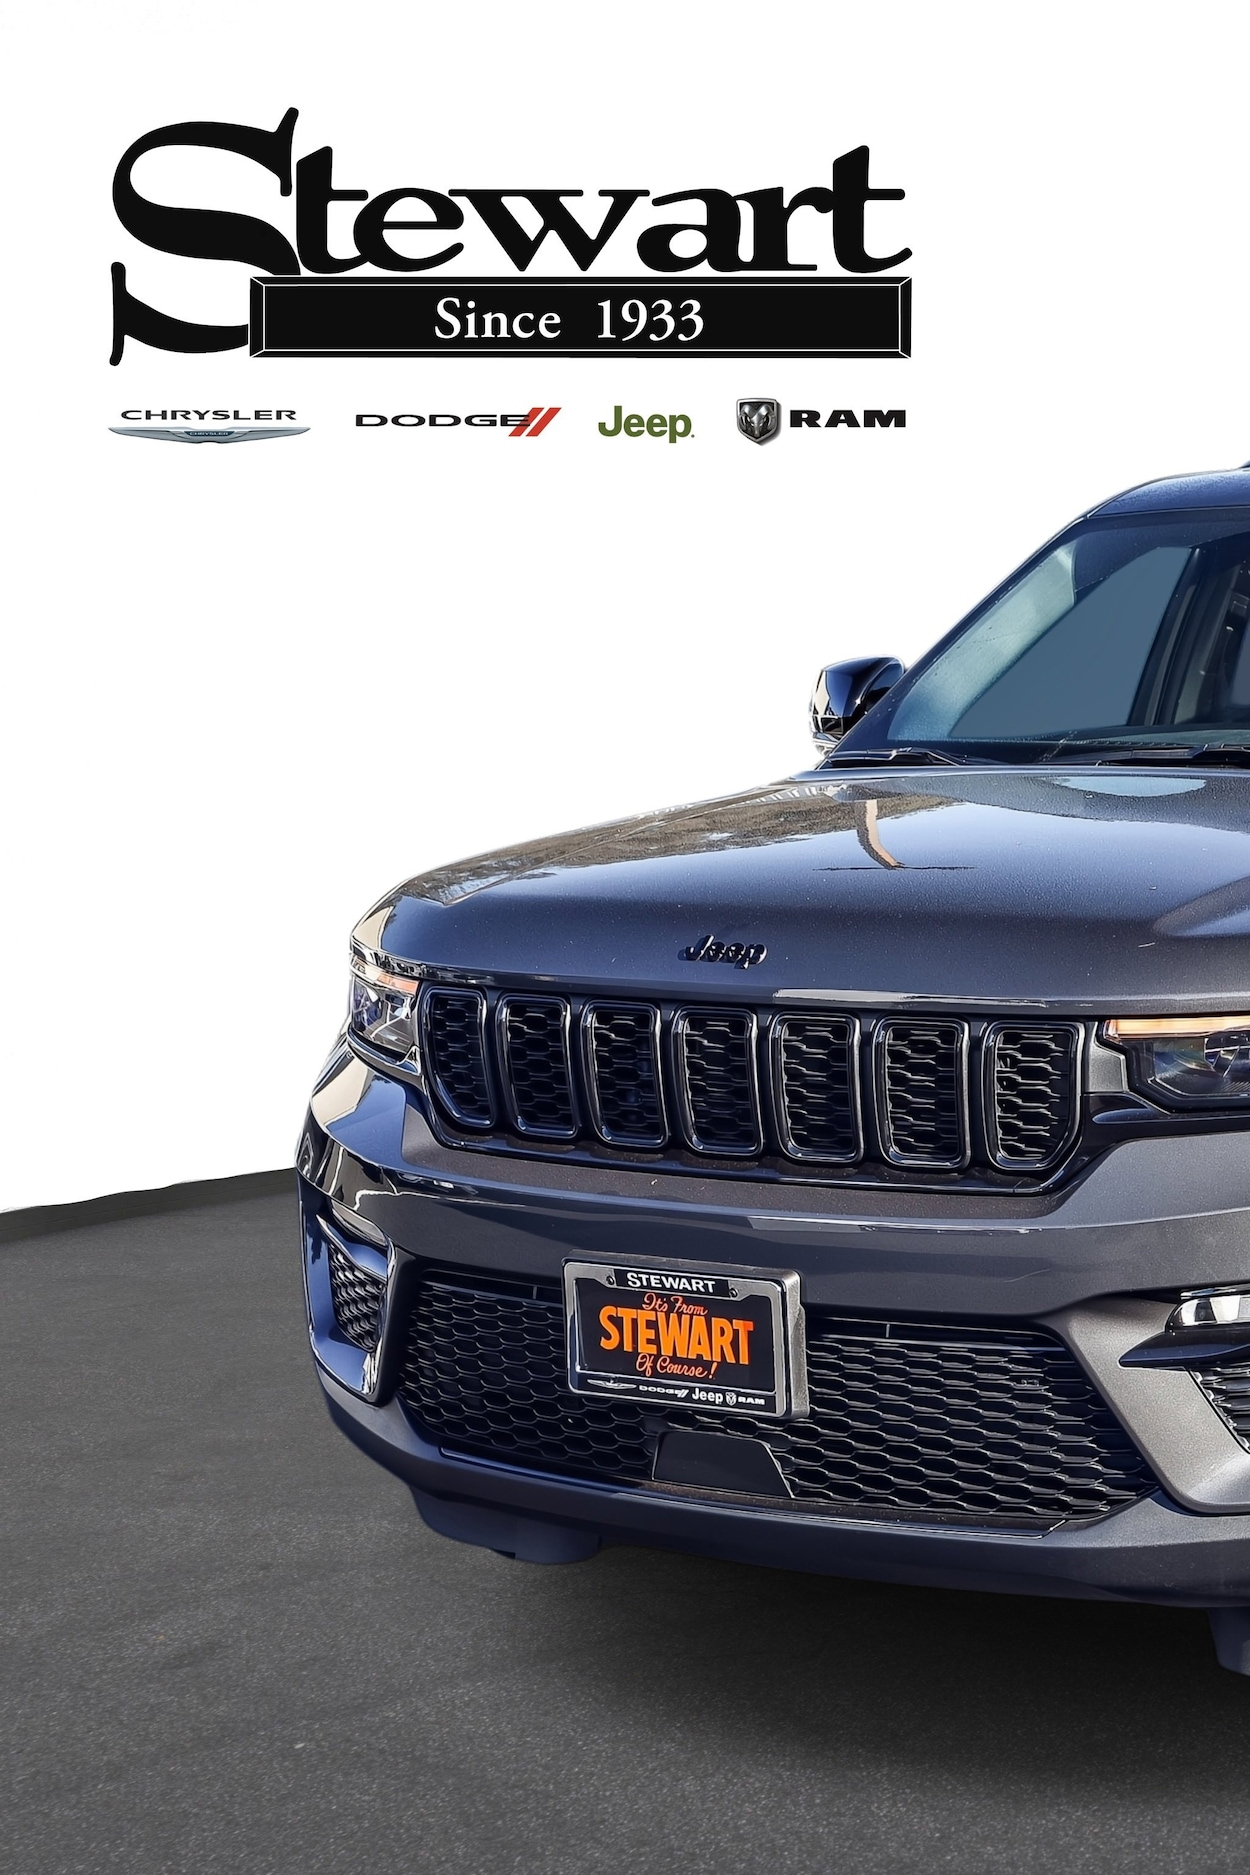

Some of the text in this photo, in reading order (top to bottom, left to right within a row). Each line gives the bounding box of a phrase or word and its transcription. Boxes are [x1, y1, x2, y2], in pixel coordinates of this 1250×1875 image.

[684, 934, 767, 970] Jeep
[627, 1272, 715, 1293] STEWART
[642, 1292, 709, 1316] It's From
[599, 1305, 754, 1365] STEWART
[636, 1353, 653, 1376] Of
[639, 1385, 766, 1406] DODGE Jeep RAM
